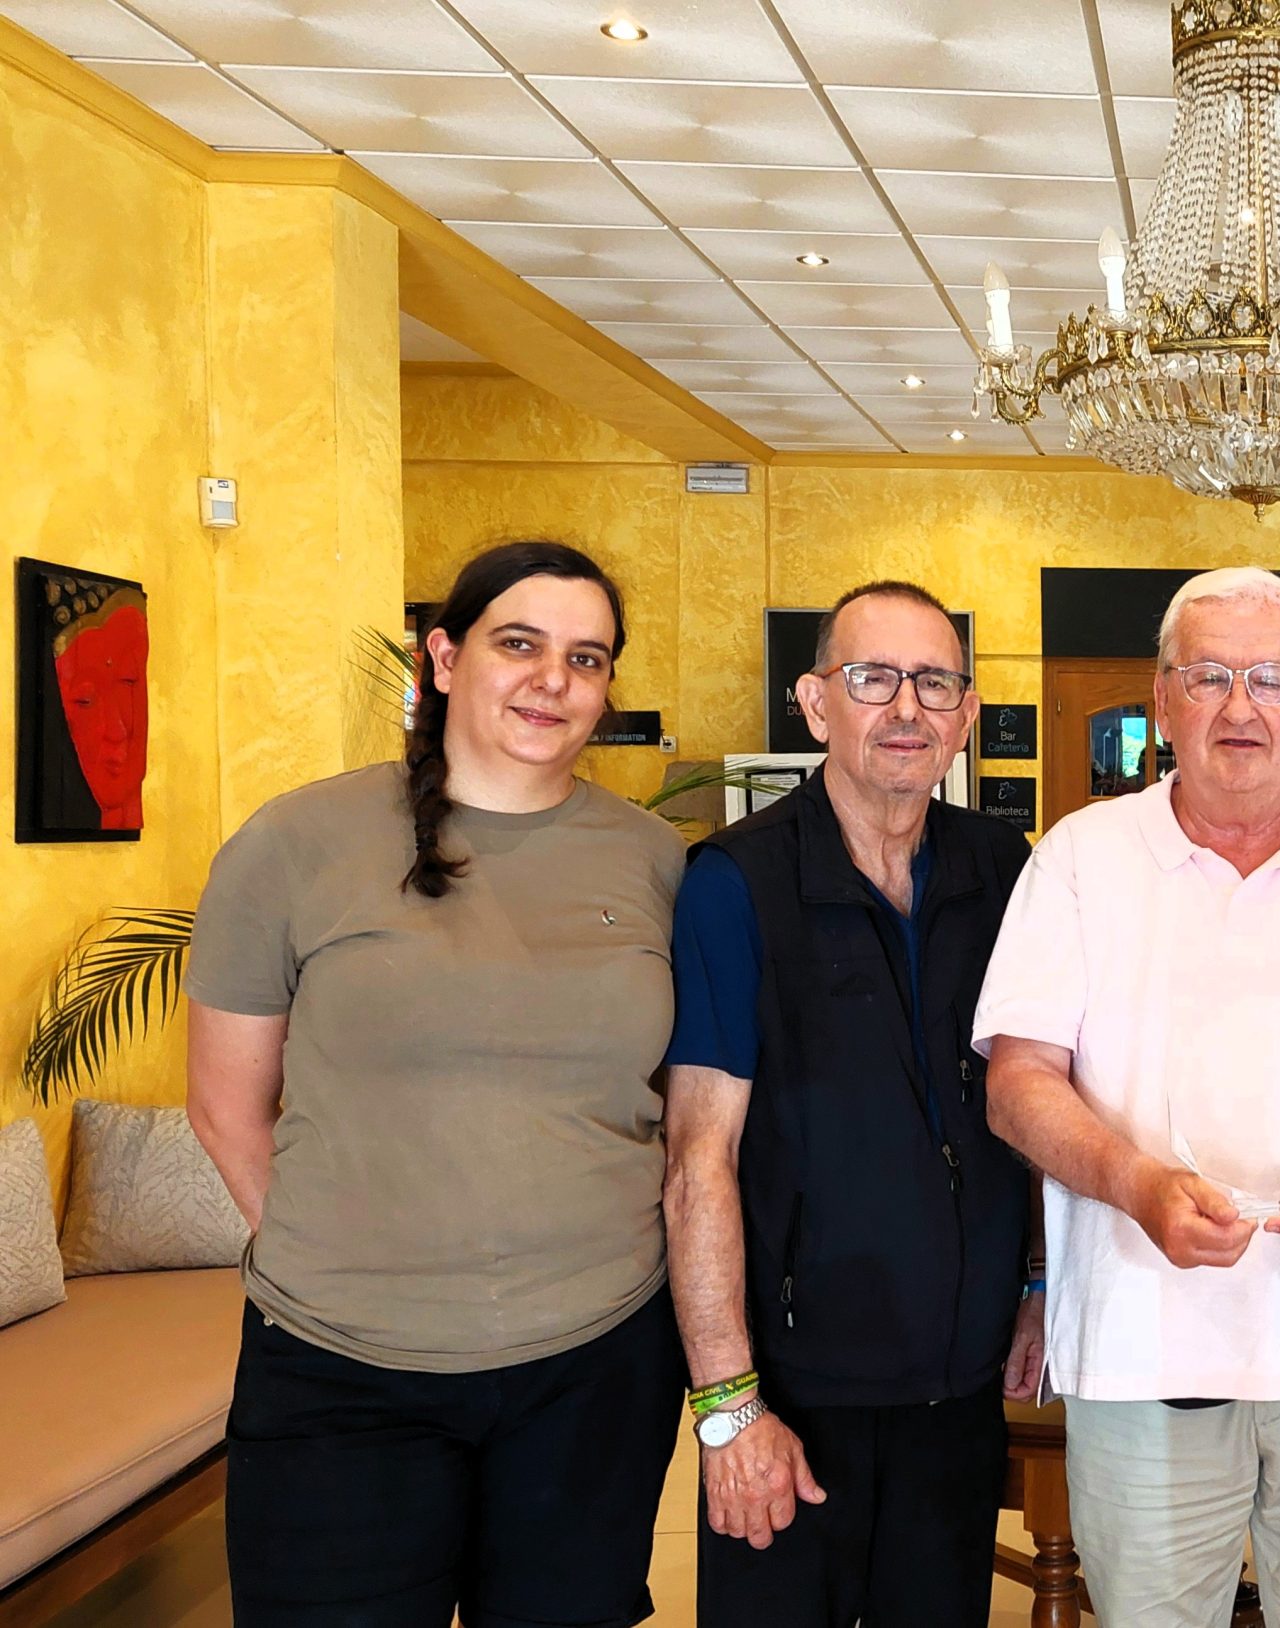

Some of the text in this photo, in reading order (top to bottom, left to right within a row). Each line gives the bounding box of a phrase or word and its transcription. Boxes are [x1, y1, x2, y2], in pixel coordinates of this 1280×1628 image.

[1000, 731, 1016, 741] Bar
[987, 742, 1030, 753] Cafetería
[986, 805, 1030, 816] Biblioteca
